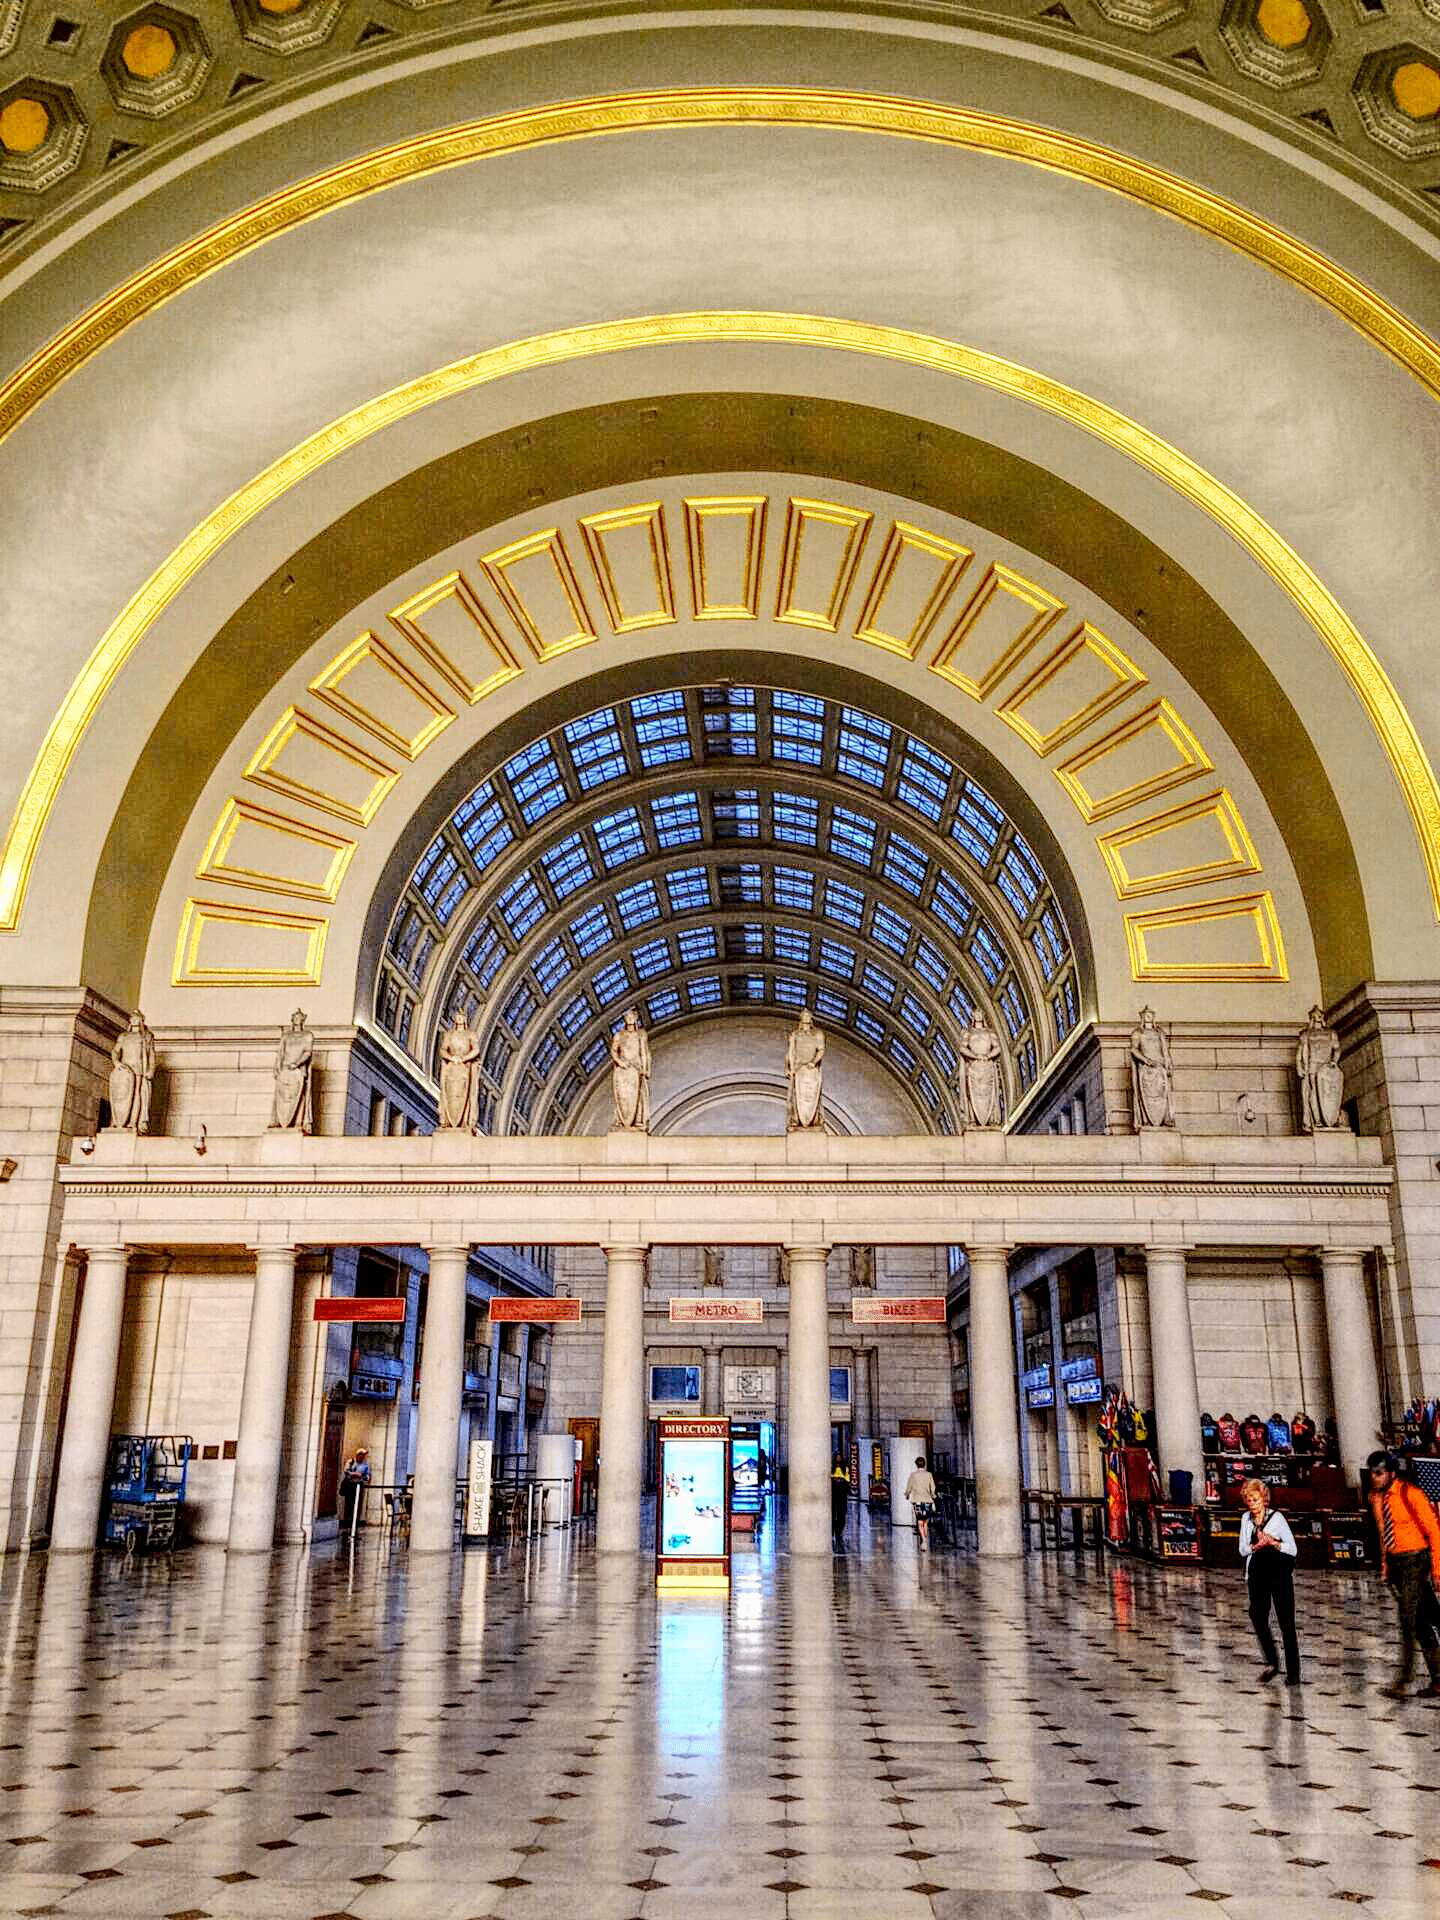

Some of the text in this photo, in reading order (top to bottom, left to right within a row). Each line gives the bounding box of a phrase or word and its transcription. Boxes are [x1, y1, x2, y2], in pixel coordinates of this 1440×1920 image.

[696, 1305, 738, 1316] METRO
[883, 1305, 916, 1315] BIKES
[665, 1425, 725, 1434] DIRECTORY
[473, 1444, 487, 1531] SHAKE SHACK
